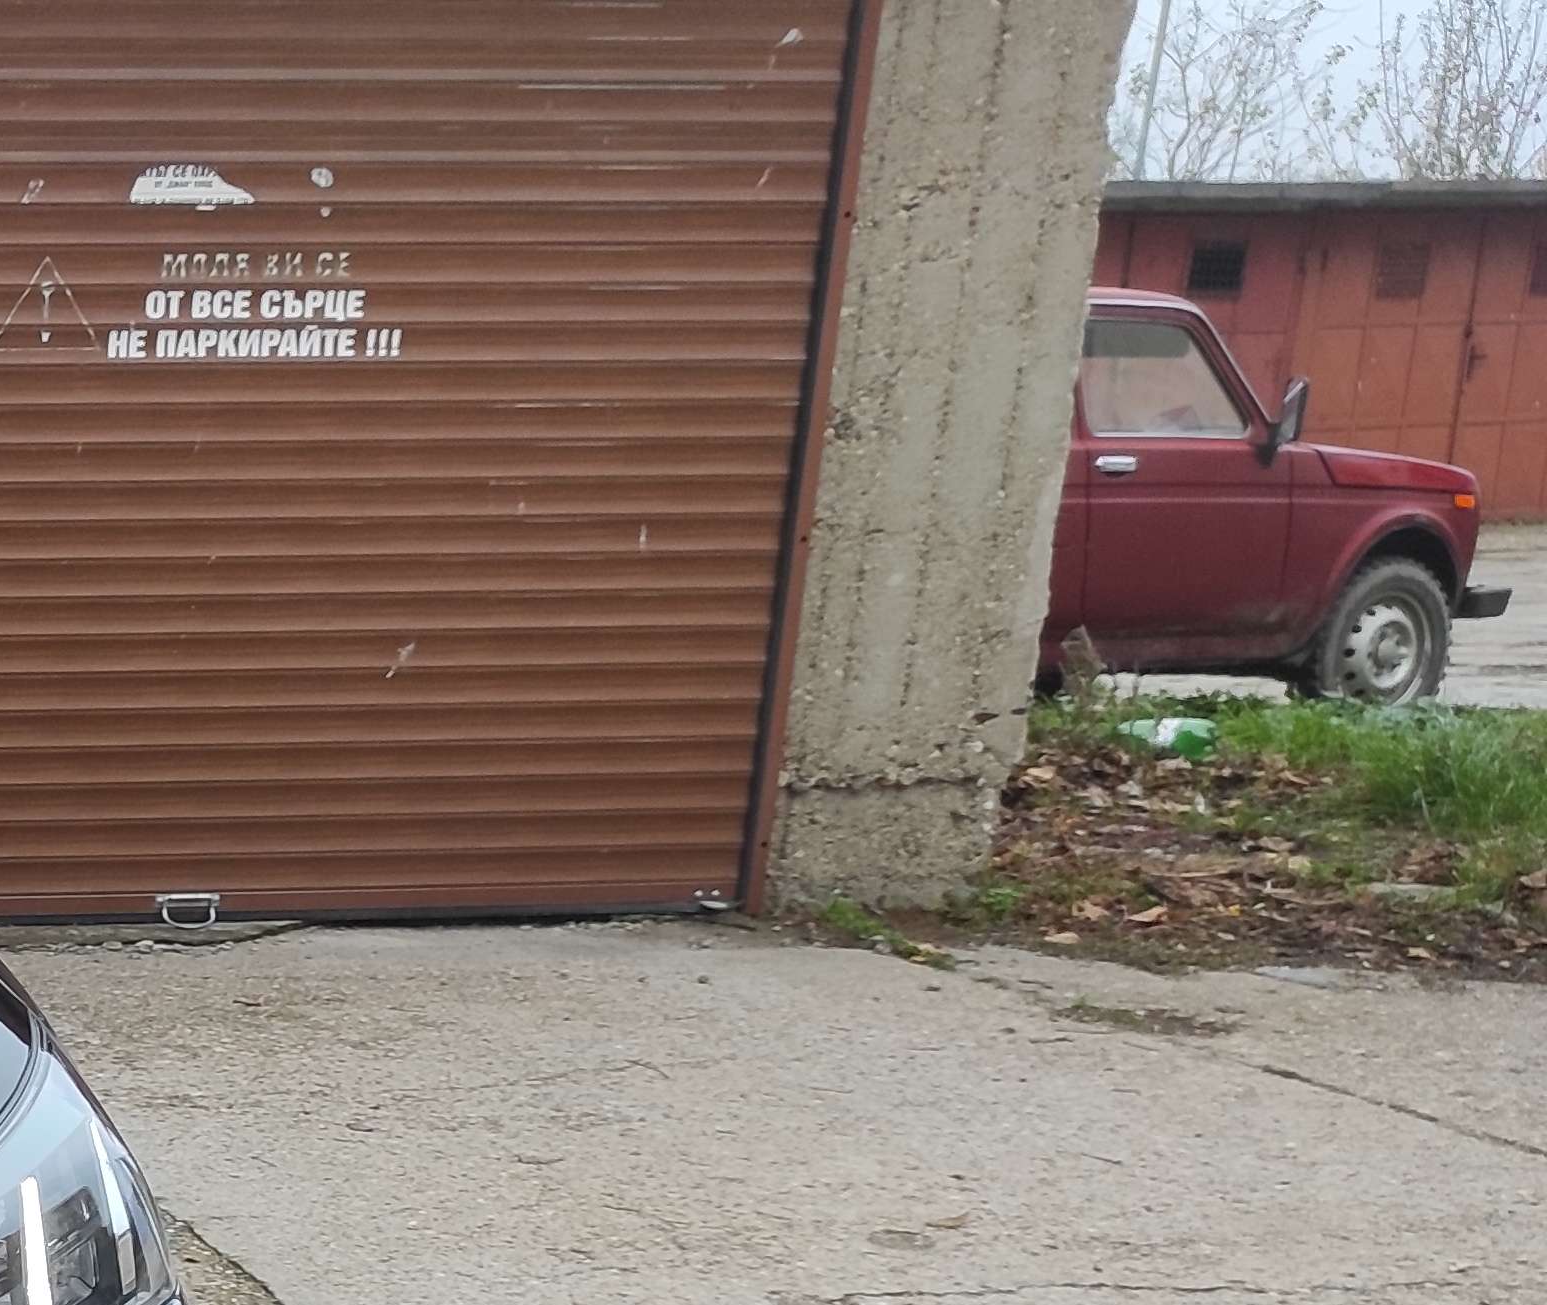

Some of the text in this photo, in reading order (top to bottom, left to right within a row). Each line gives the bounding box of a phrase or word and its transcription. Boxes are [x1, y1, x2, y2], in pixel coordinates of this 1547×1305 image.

[145, 289, 367, 322] ОТ ВСЕ СЪРЦЕ
[107, 324, 403, 358] НЕ ПАРКИРАЙТЕ !!!
